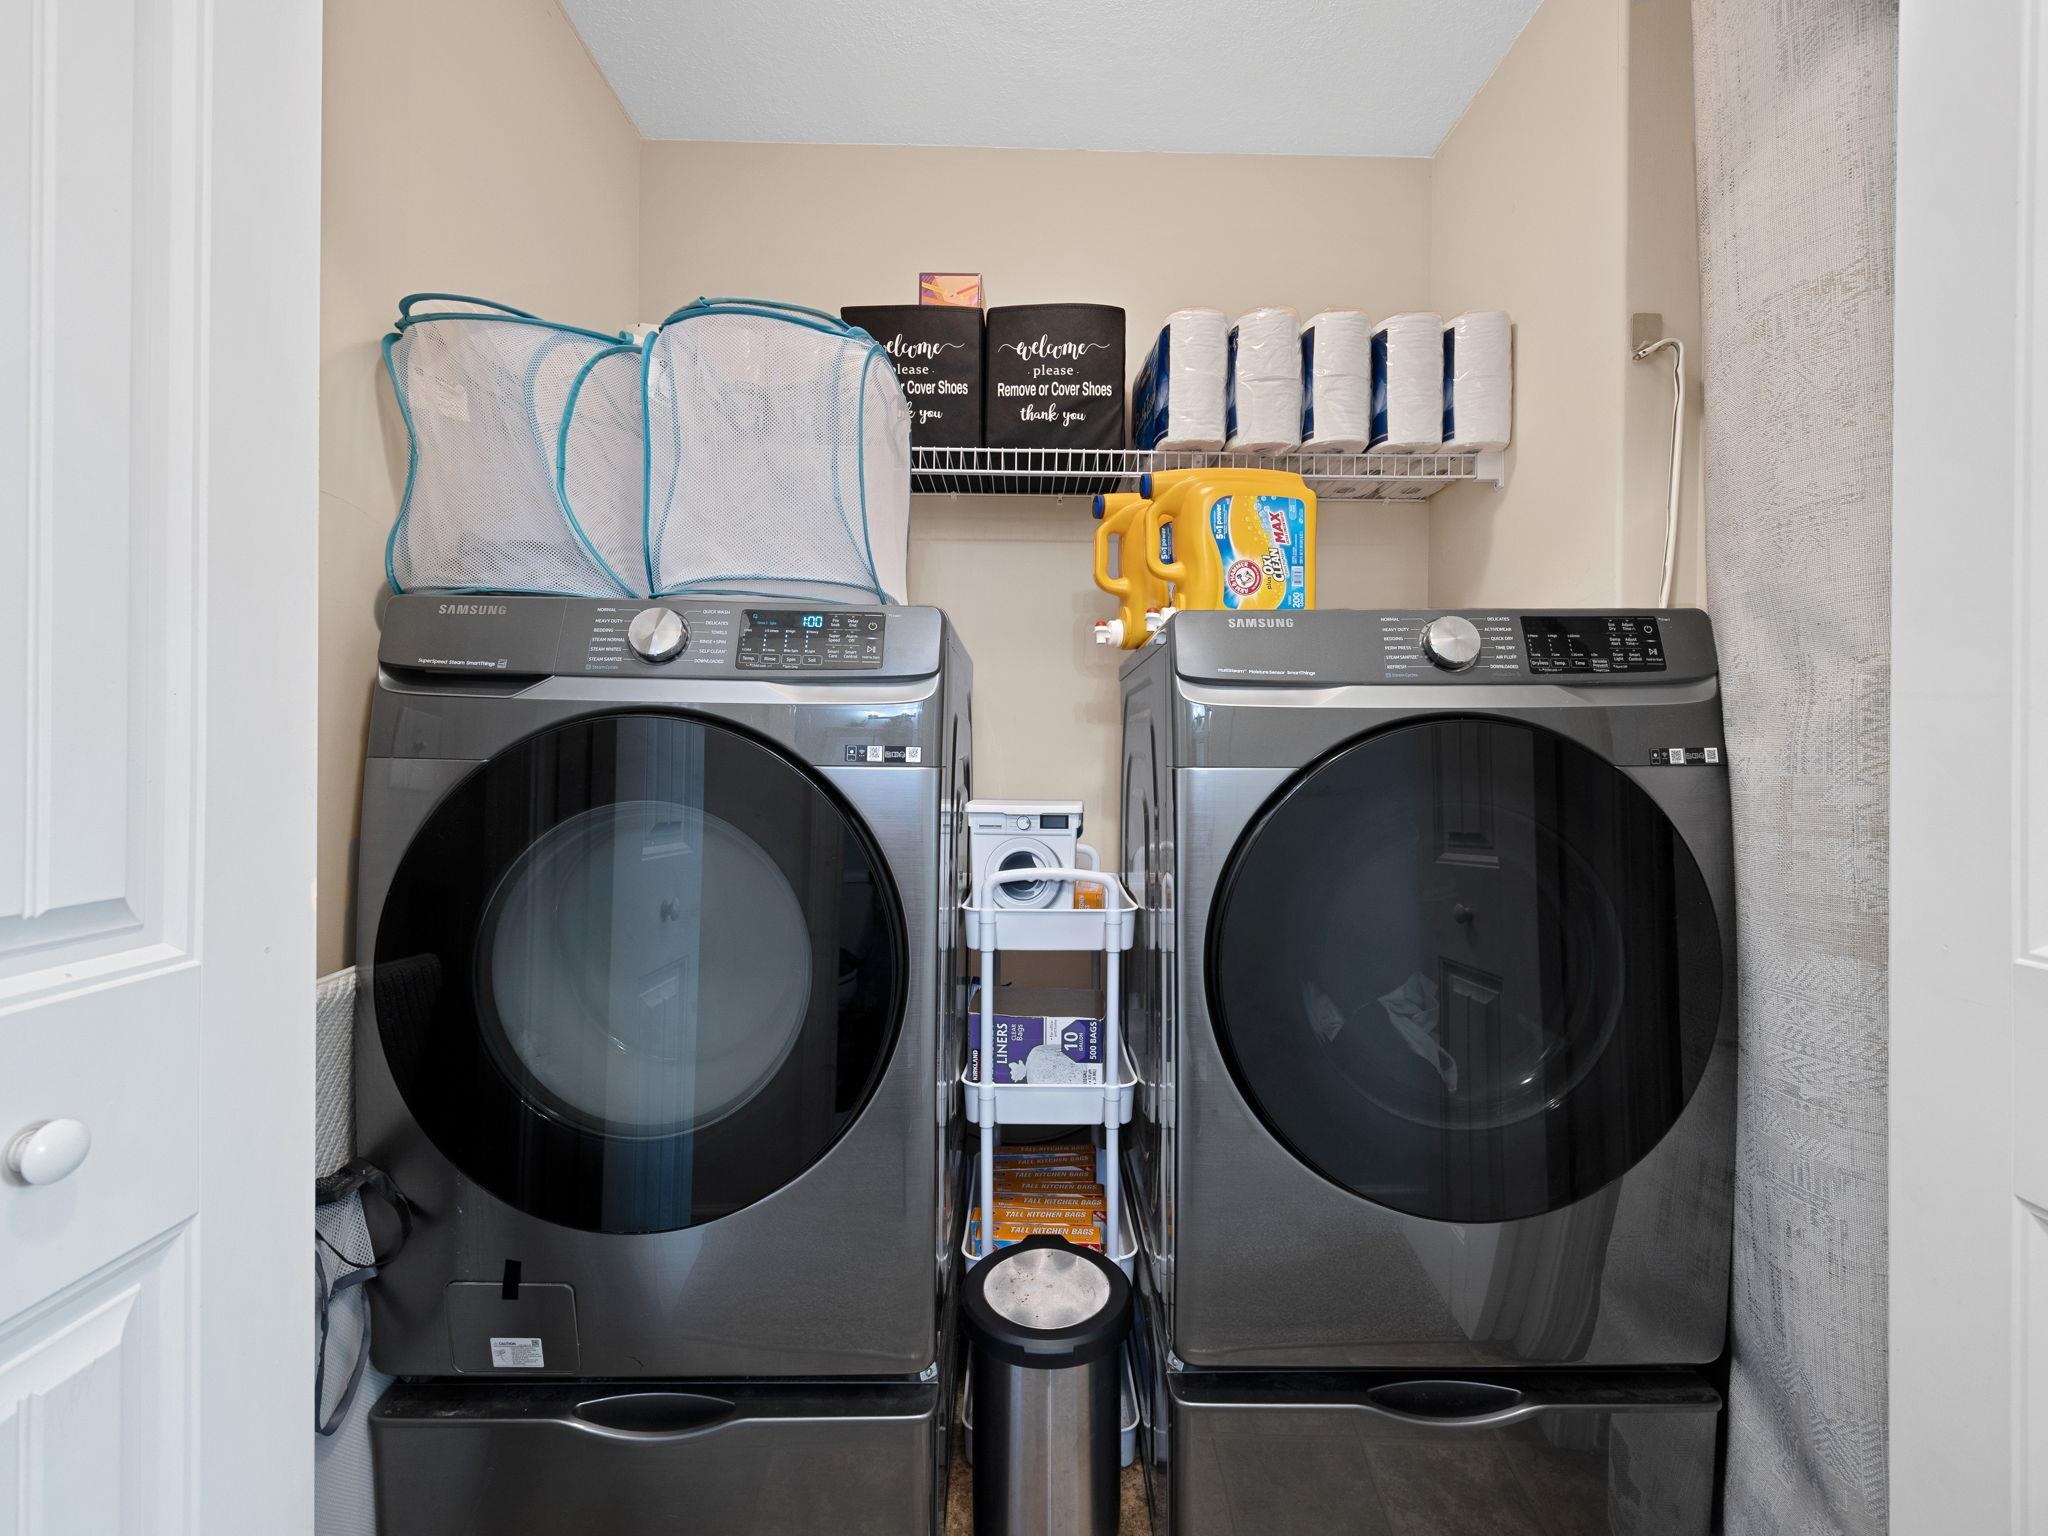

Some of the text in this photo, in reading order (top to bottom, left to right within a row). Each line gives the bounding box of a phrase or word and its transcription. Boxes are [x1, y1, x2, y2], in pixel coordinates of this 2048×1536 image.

[884, 334, 965, 359] elcome
[998, 334, 1110, 360] welcome
[1033, 365, 1074, 378] please
[907, 380, 935, 394] Cover
[938, 380, 968, 394] Shoes
[997, 381, 1112, 397] Remove or Cover Shoes
[919, 408, 943, 424] you
[1020, 403, 1087, 427] thank you
[1269, 512, 1286, 544] MAX
[1230, 562, 1248, 582] HAMMER
[1262, 555, 1274, 575] OXI
[1269, 548, 1285, 582] CLEAN
[438, 604, 507, 615] SAMSUNG
[1228, 618, 1294, 628] SAMSUNG
[996, 1023, 1008, 1064] LINERS
[1064, 1031, 1078, 1051] 10
